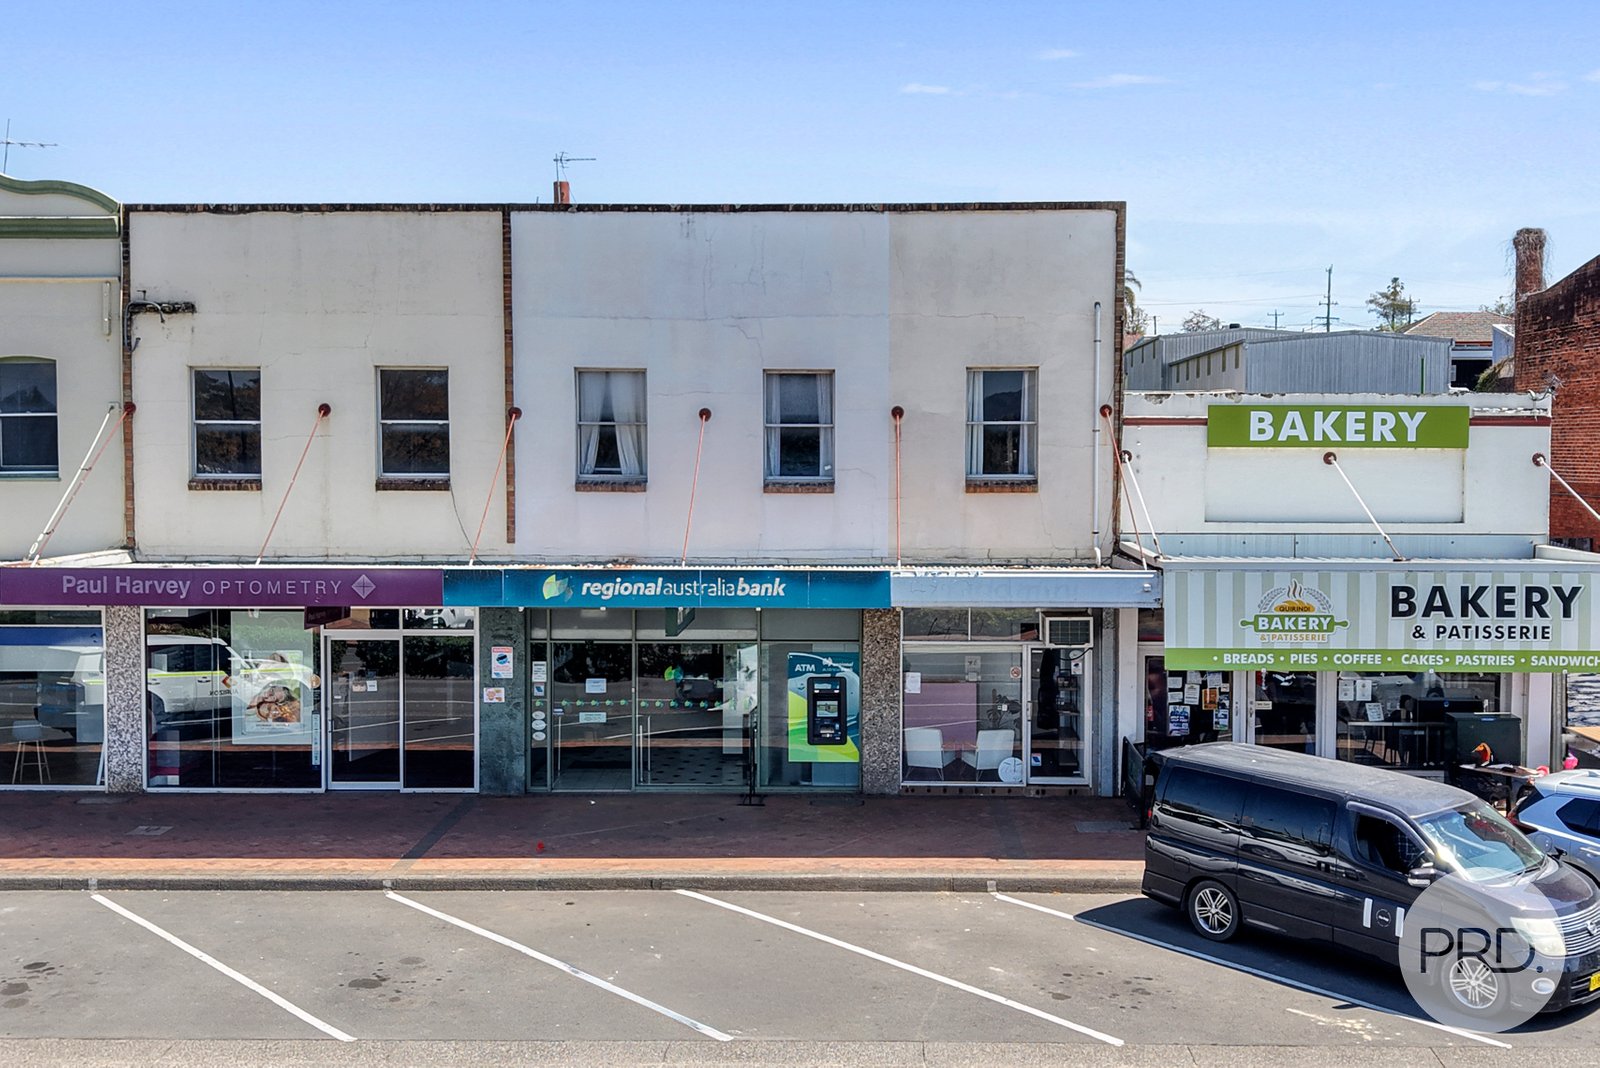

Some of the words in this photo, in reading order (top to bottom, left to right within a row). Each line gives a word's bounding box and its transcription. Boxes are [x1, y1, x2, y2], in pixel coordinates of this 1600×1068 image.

[1250, 411, 1427, 442] BAKERY
[62, 575, 107, 594] Paul
[115, 575, 191, 599] Harvey
[202, 580, 342, 595] OPTOMETRY
[1391, 586, 1582, 618] BAKERY
[1258, 617, 1331, 630] BAKERY
[1412, 625, 1426, 639] &
[1436, 626, 1550, 640] PATISSERIE
[1223, 653, 1274, 664] BREADS
[1290, 654, 1318, 664] PIES
[1333, 654, 1382, 664] COFFEE
[1401, 654, 1443, 665] CAKES
[1455, 655, 1515, 665] PASTRIES
